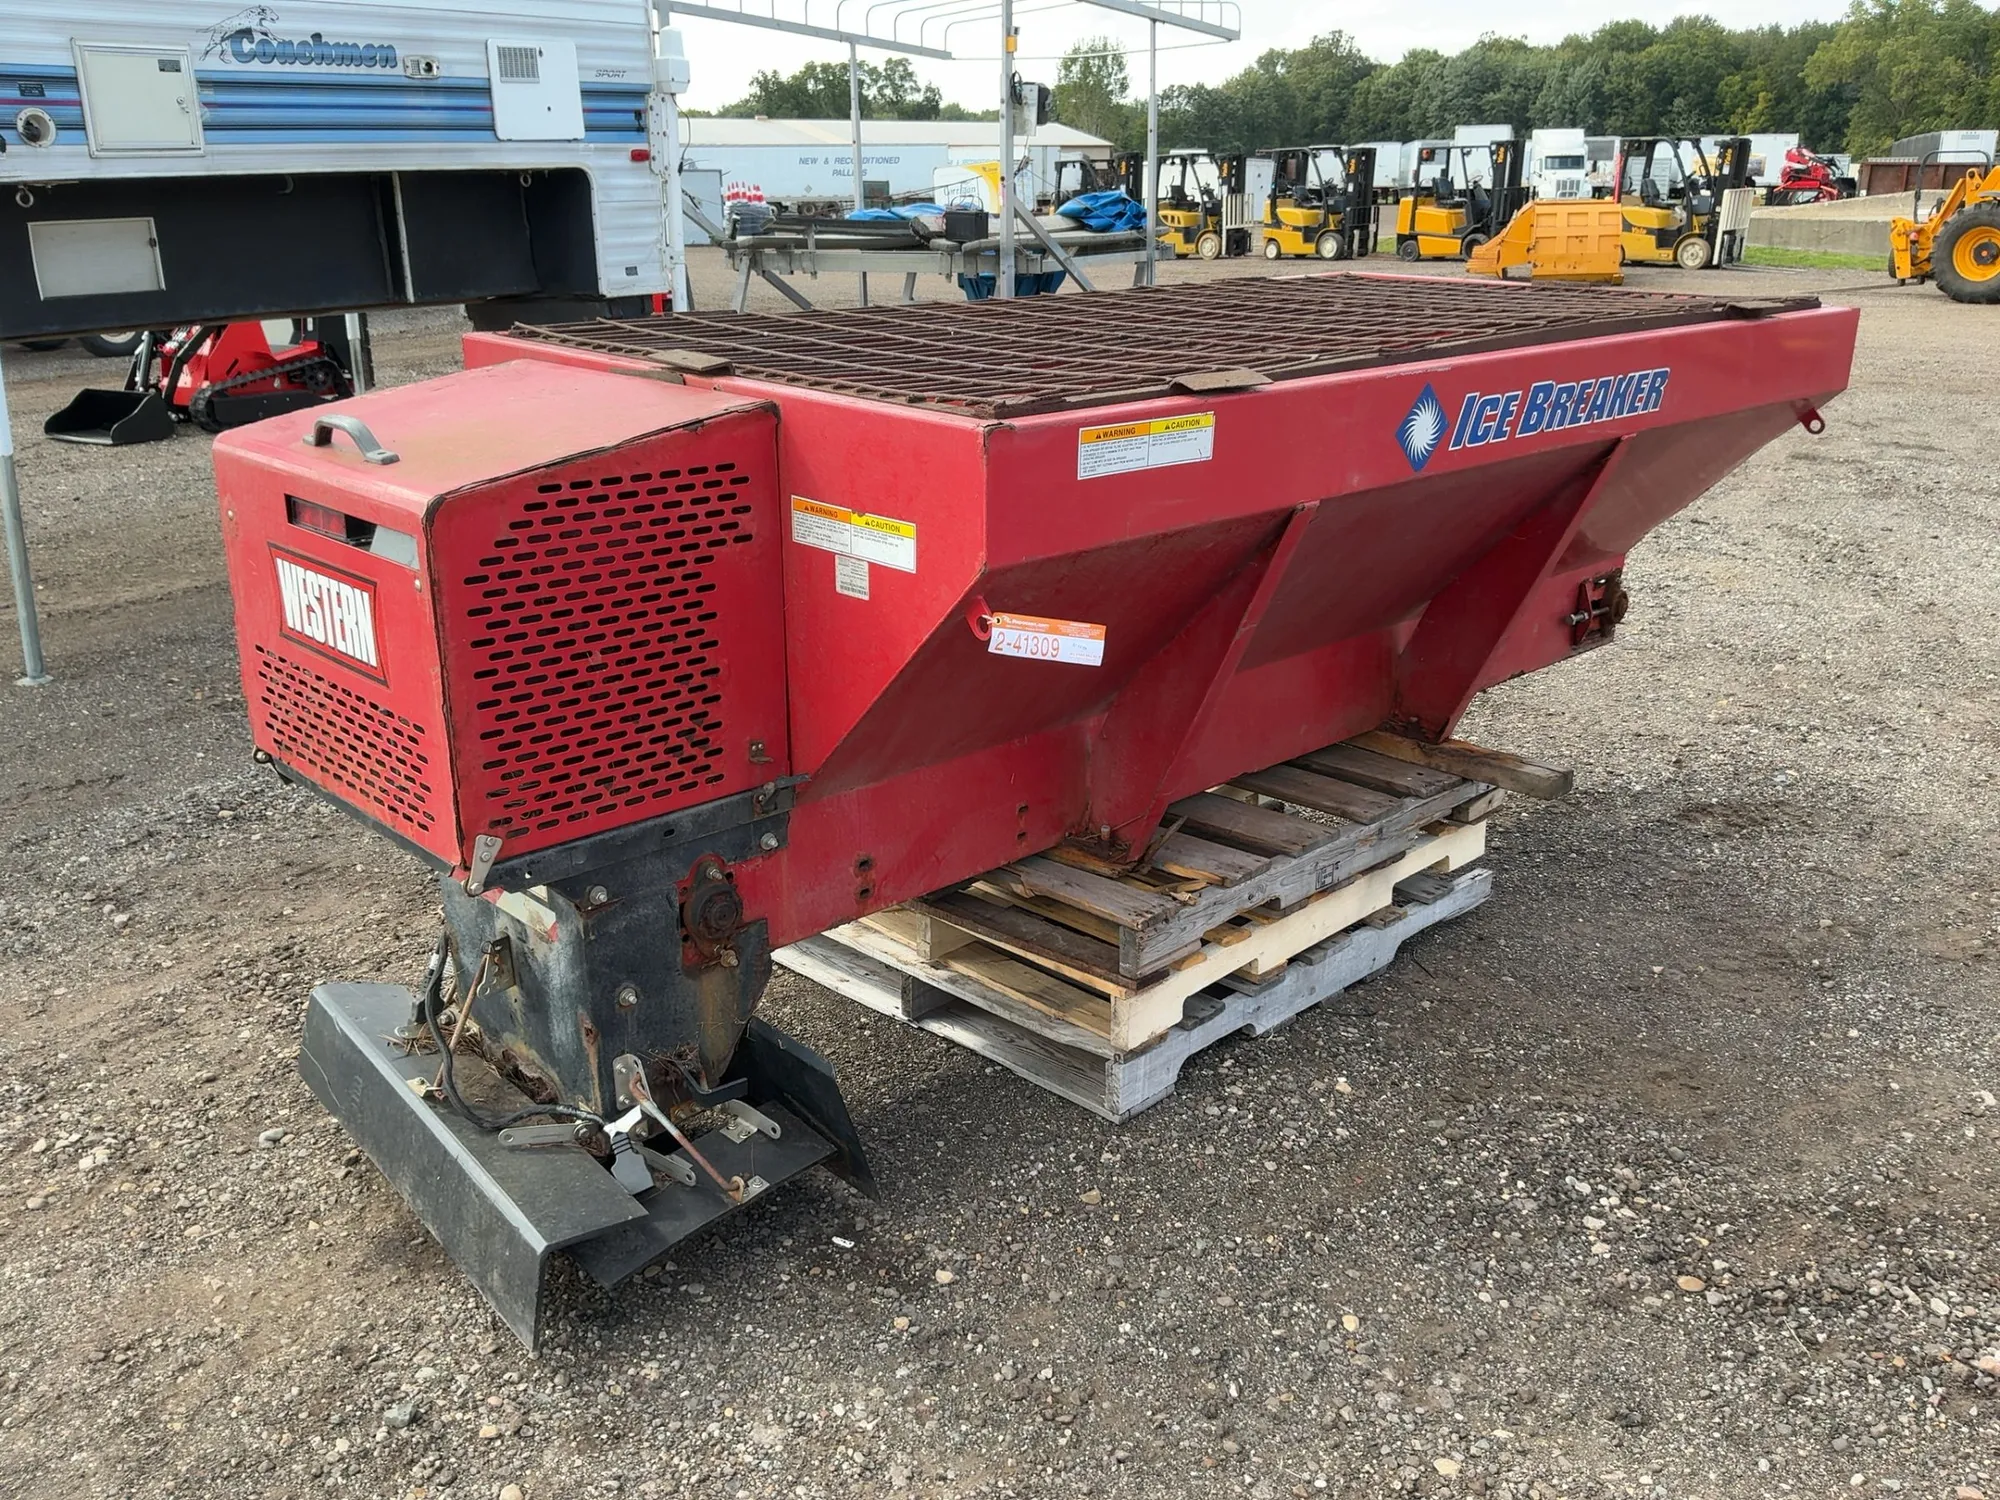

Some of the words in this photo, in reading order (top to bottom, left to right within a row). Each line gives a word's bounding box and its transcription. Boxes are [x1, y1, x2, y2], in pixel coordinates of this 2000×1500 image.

[230, 27, 398, 68] Coachmen
[595, 69, 627, 78] SPORT
[799, 157, 818, 165] NEW
[823, 157, 829, 165] &
[834, 156, 900, 165] RECDITIONED
[832, 168, 868, 177] PALLS
[1449, 390, 1523, 451] ICE
[1515, 368, 1671, 439] BREAKER
[1171, 419, 1201, 430] CAUTION
[1103, 427, 1136, 438] WARNING
[809, 506, 838, 519] WARNING
[870, 520, 901, 533] CAUTION
[276, 557, 378, 668] WESTERN
[994, 631, 1060, 658] 2-41309
